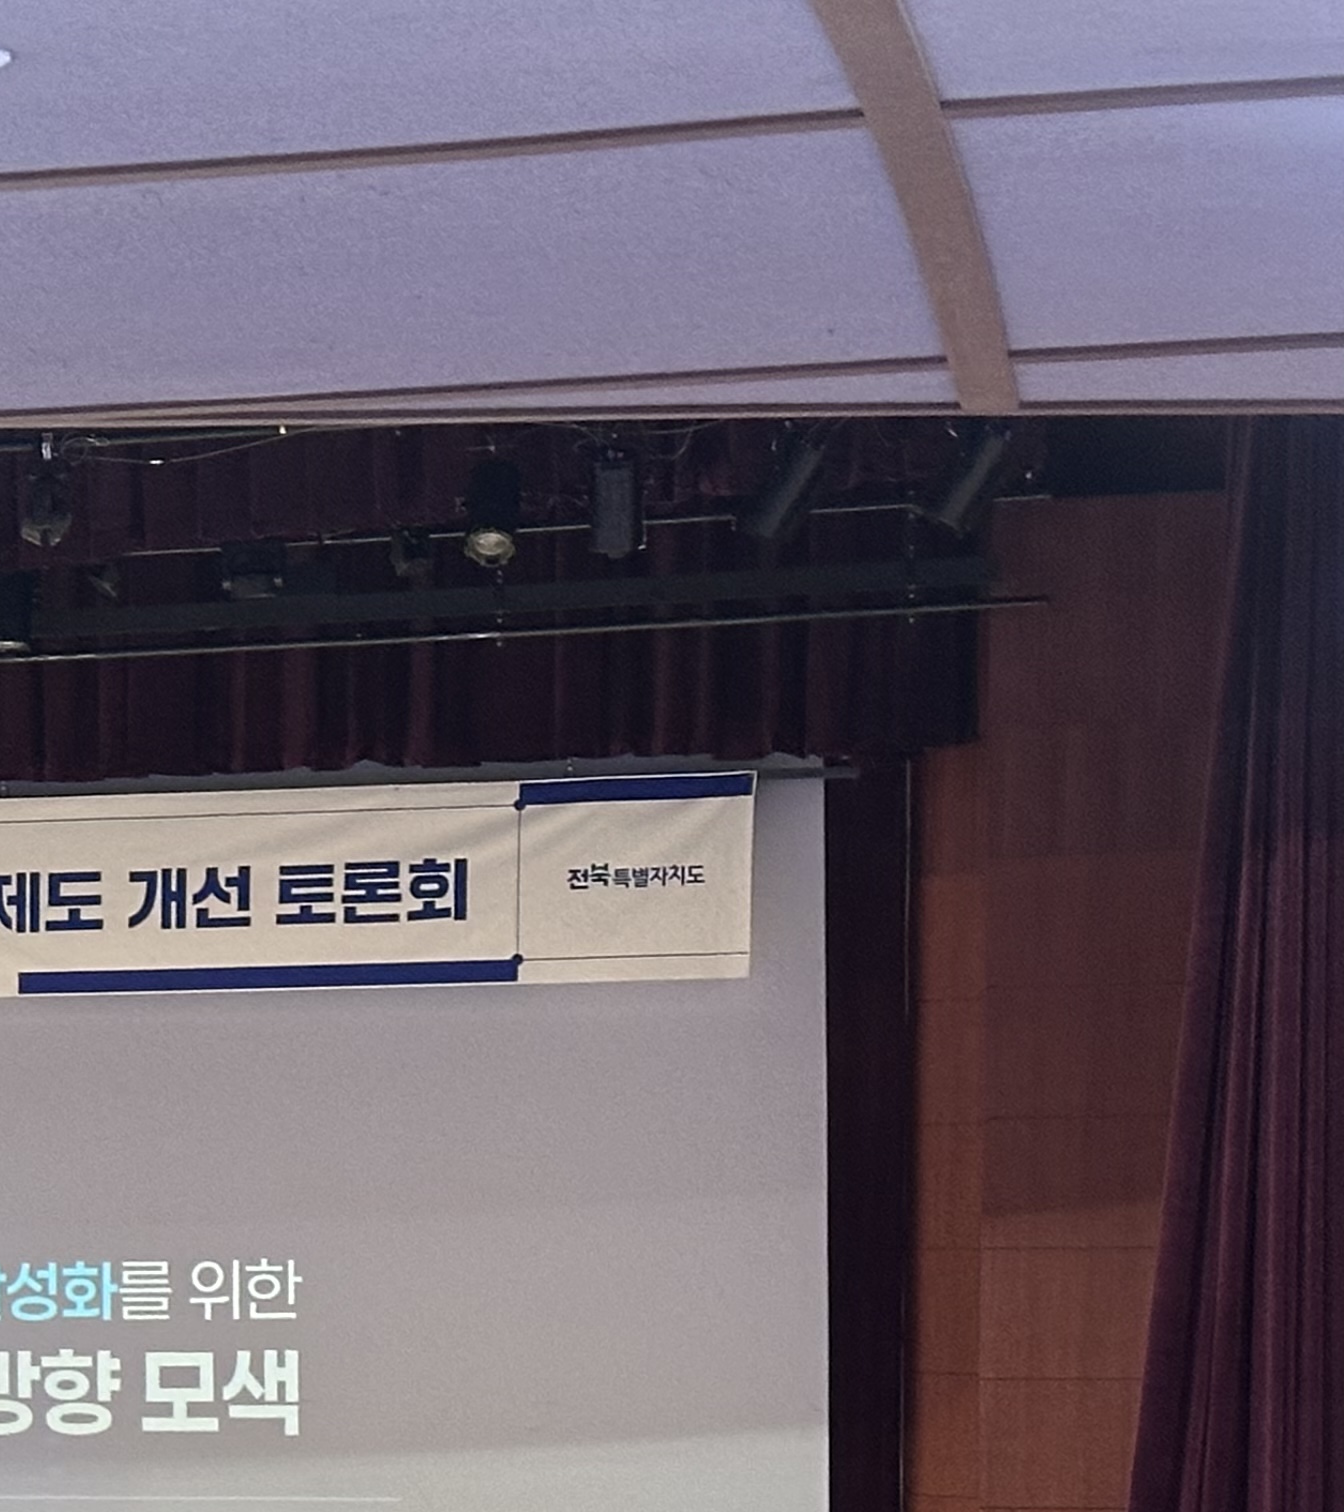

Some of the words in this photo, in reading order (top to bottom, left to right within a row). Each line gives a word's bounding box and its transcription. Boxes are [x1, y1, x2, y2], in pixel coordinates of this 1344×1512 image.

[127, 865, 252, 930] 개선
[275, 858, 468, 925] 토론회
[567, 863, 705, 890] 전북특별자치도
[189, 1257, 303, 1321] 위한
[141, 1349, 300, 1436] 모색
